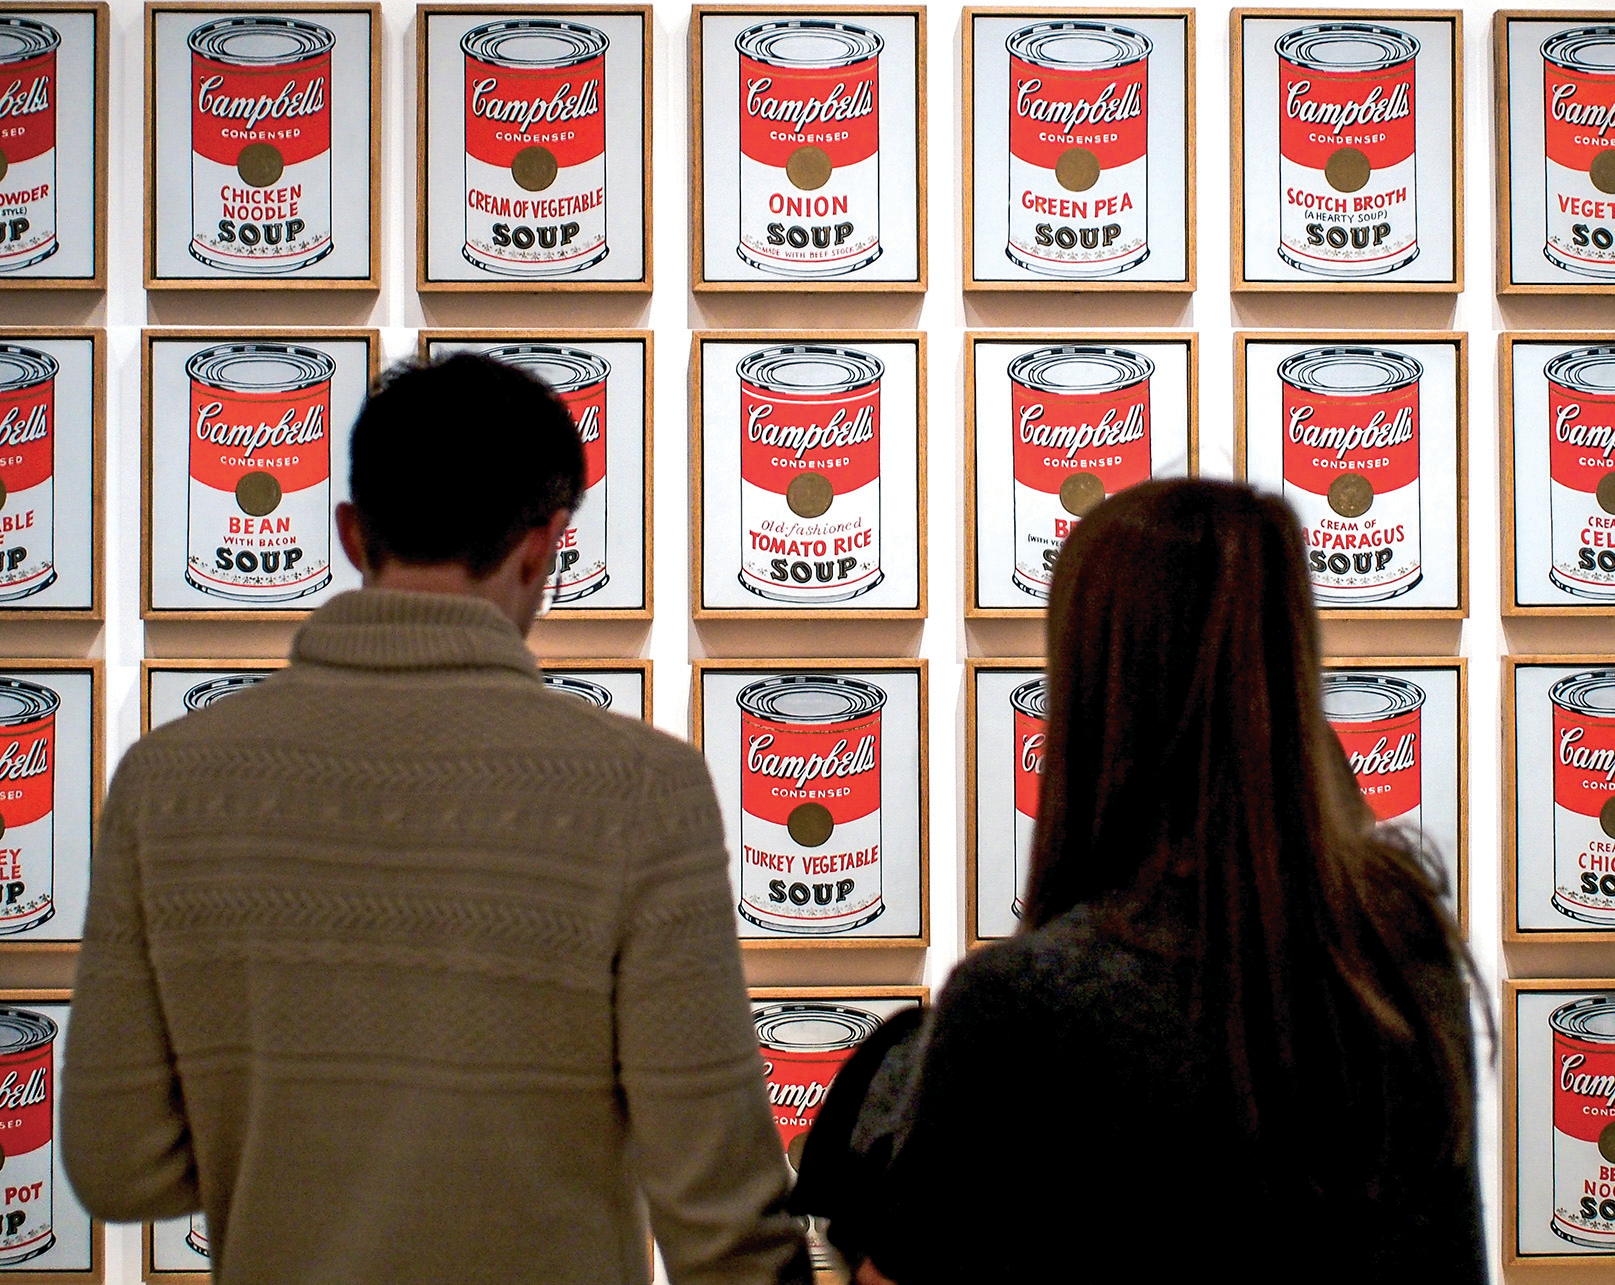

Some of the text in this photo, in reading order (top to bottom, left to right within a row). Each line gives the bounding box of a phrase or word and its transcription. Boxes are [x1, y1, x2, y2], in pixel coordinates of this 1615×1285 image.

[199, 75, 325, 130] Campbell's
[472, 78, 599, 133] Campbell's
[746, 77, 874, 133] Campbell's
[1017, 78, 1142, 134] Campbell's
[1286, 80, 1410, 135] Campbell's
[221, 128, 301, 140] CONDENSED
[495, 131, 575, 142] CONDENSED
[769, 131, 849, 142] CONDENSED
[1039, 132, 1118, 144] CONDENSED
[1309, 133, 1386, 144] CONDENSED
[220, 184, 302, 205] CHICKEN
[468, 186, 603, 219] CREAM OF VEGETABLE
[769, 192, 848, 217] ONION
[1022, 190, 1133, 219] GREEN PEA
[1287, 186, 1407, 213] SCOTCH BROTH
[223, 202, 299, 221] NOODLE
[1316, 211, 1355, 223] HEARTY
[1358, 209, 1388, 222] SOUP)
[218, 218, 306, 246] SOUP
[492, 221, 580, 249] SOUP
[767, 221, 854, 249] SOUP
[1035, 222, 1121, 249] SOUP
[1306, 222, 1391, 249] SOUP
[761, 246, 854, 259] MADE WITH BEEF STOCK
[196, 402, 324, 459] Campbell's
[748, 403, 874, 460] Campbell's
[1019, 402, 1145, 460] Campbell's
[1289, 405, 1414, 460] Campbell's
[220, 455, 300, 468] CONDENSED
[771, 456, 850, 469] CONDENSED
[1043, 455, 1123, 468] CONDENSED
[1312, 457, 1390, 469] CONDENSED
[0, 509, 34, 533] BLE
[229, 516, 290, 534] BEAN
[761, 516, 862, 538] Old-fashioned
[1320, 518, 1377, 531] CREAM OF
[223, 536, 297, 548] WITH BACON
[749, 528, 872, 558] TOMATO RICE
[1027, 533, 1049, 545] (WITH
[215, 546, 302, 573] SOUP
[770, 557, 857, 583] SOUP
[1309, 547, 1393, 574] SOUP
[747, 733, 875, 789] Campbell's
[771, 787, 851, 799] CONDENSED
[743, 844, 879, 875] TURKEY VEGETABLE
[768, 878, 855, 906] SOUP
[5, 1181, 43, 1206] POT
